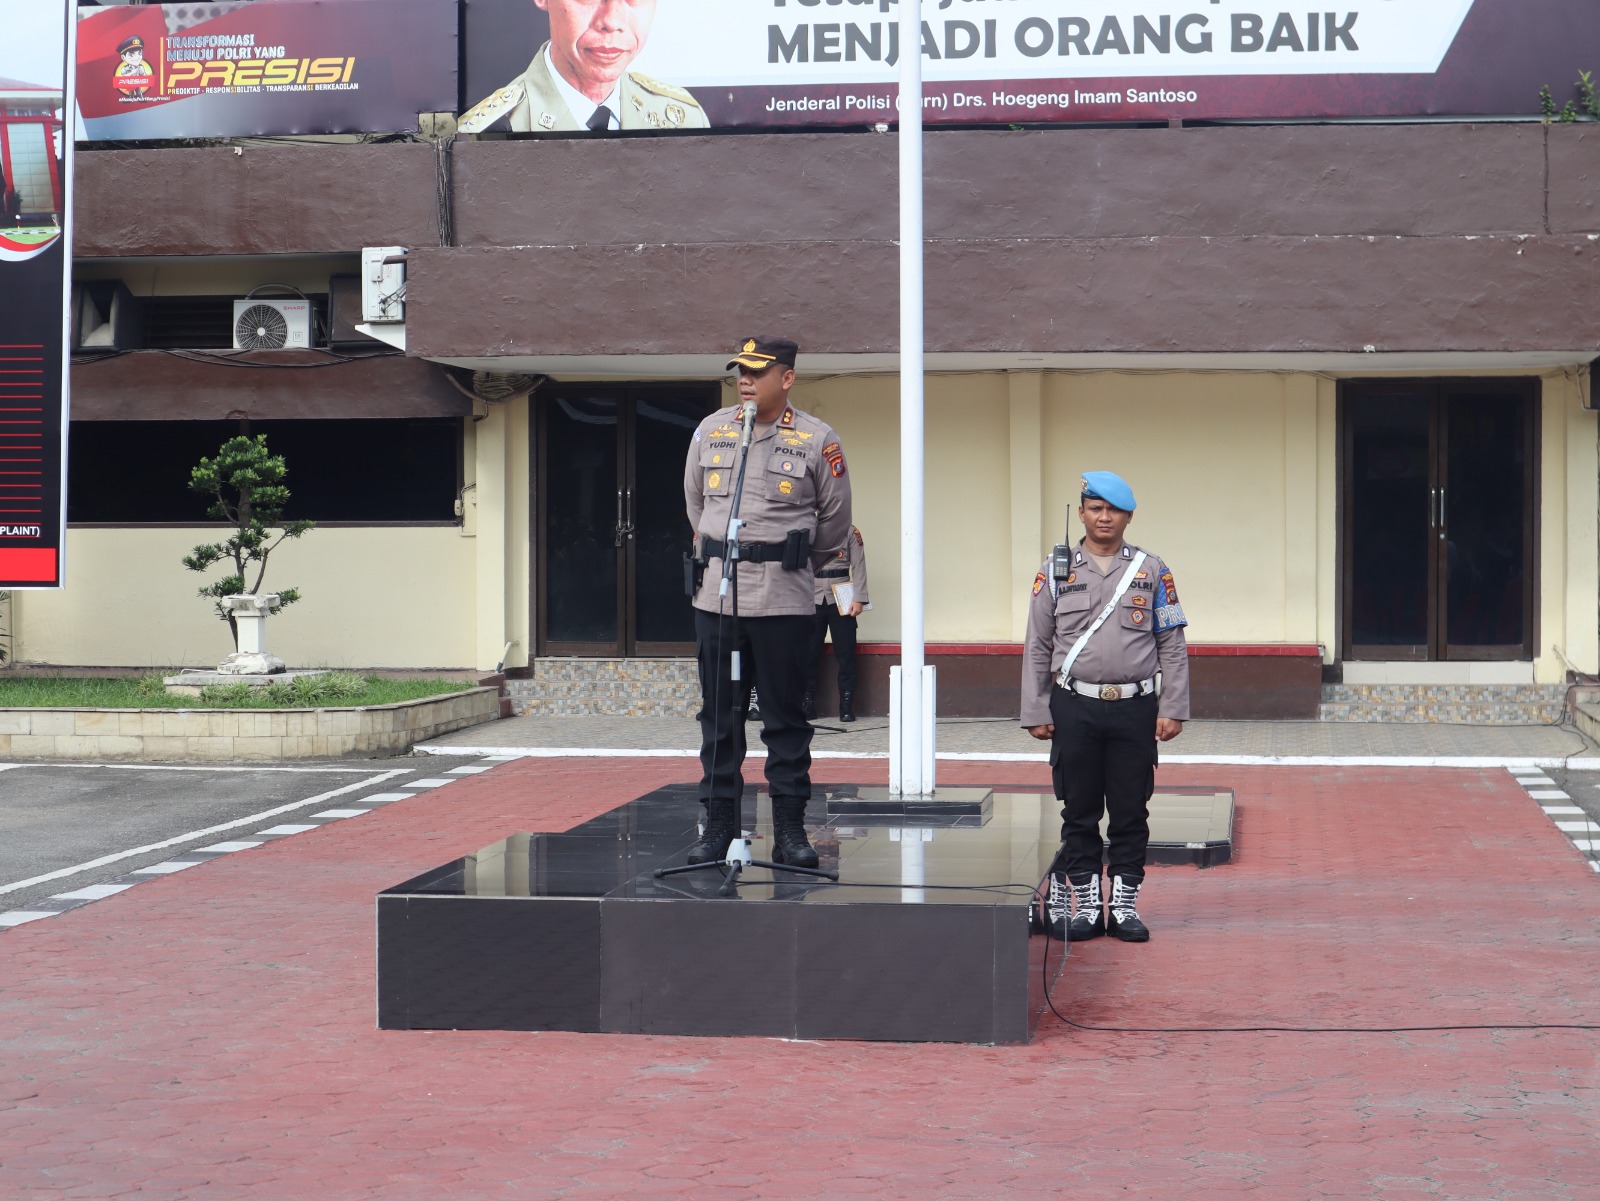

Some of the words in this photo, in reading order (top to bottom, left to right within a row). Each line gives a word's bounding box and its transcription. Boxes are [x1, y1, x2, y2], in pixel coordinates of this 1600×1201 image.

[166, 34, 255, 48] TRANSFORMASI
[767, 19, 997, 67] MENJADI
[1014, 13, 1213, 57] ORANG
[1230, 12, 1359, 52] BAIK
[167, 47, 214, 61] MENUJU
[216, 47, 251, 60] POLRI
[254, 46, 285, 59] YANG
[167, 57, 355, 87] PRESISI
[167, 87, 200, 95] PREDIKTIF
[205, 86, 261, 94] RESPONSIBILITAS
[266, 84, 314, 92] TRANSPARANSI
[315, 83, 359, 91] BERKEADILAN
[765, 96, 840, 111] Jenderal
[845, 94, 890, 109] Polisi
[895, 93, 948, 111] (rn)
[953, 93, 987, 107] Drs.
[992, 91, 1069, 109] Hoegeng
[1074, 90, 1122, 104] Imam
[1126, 88, 1198, 103] Santoso
[709, 441, 737, 450] YUDHI
[774, 446, 807, 459] POLRI
[1129, 581, 1153, 590] OLRI
